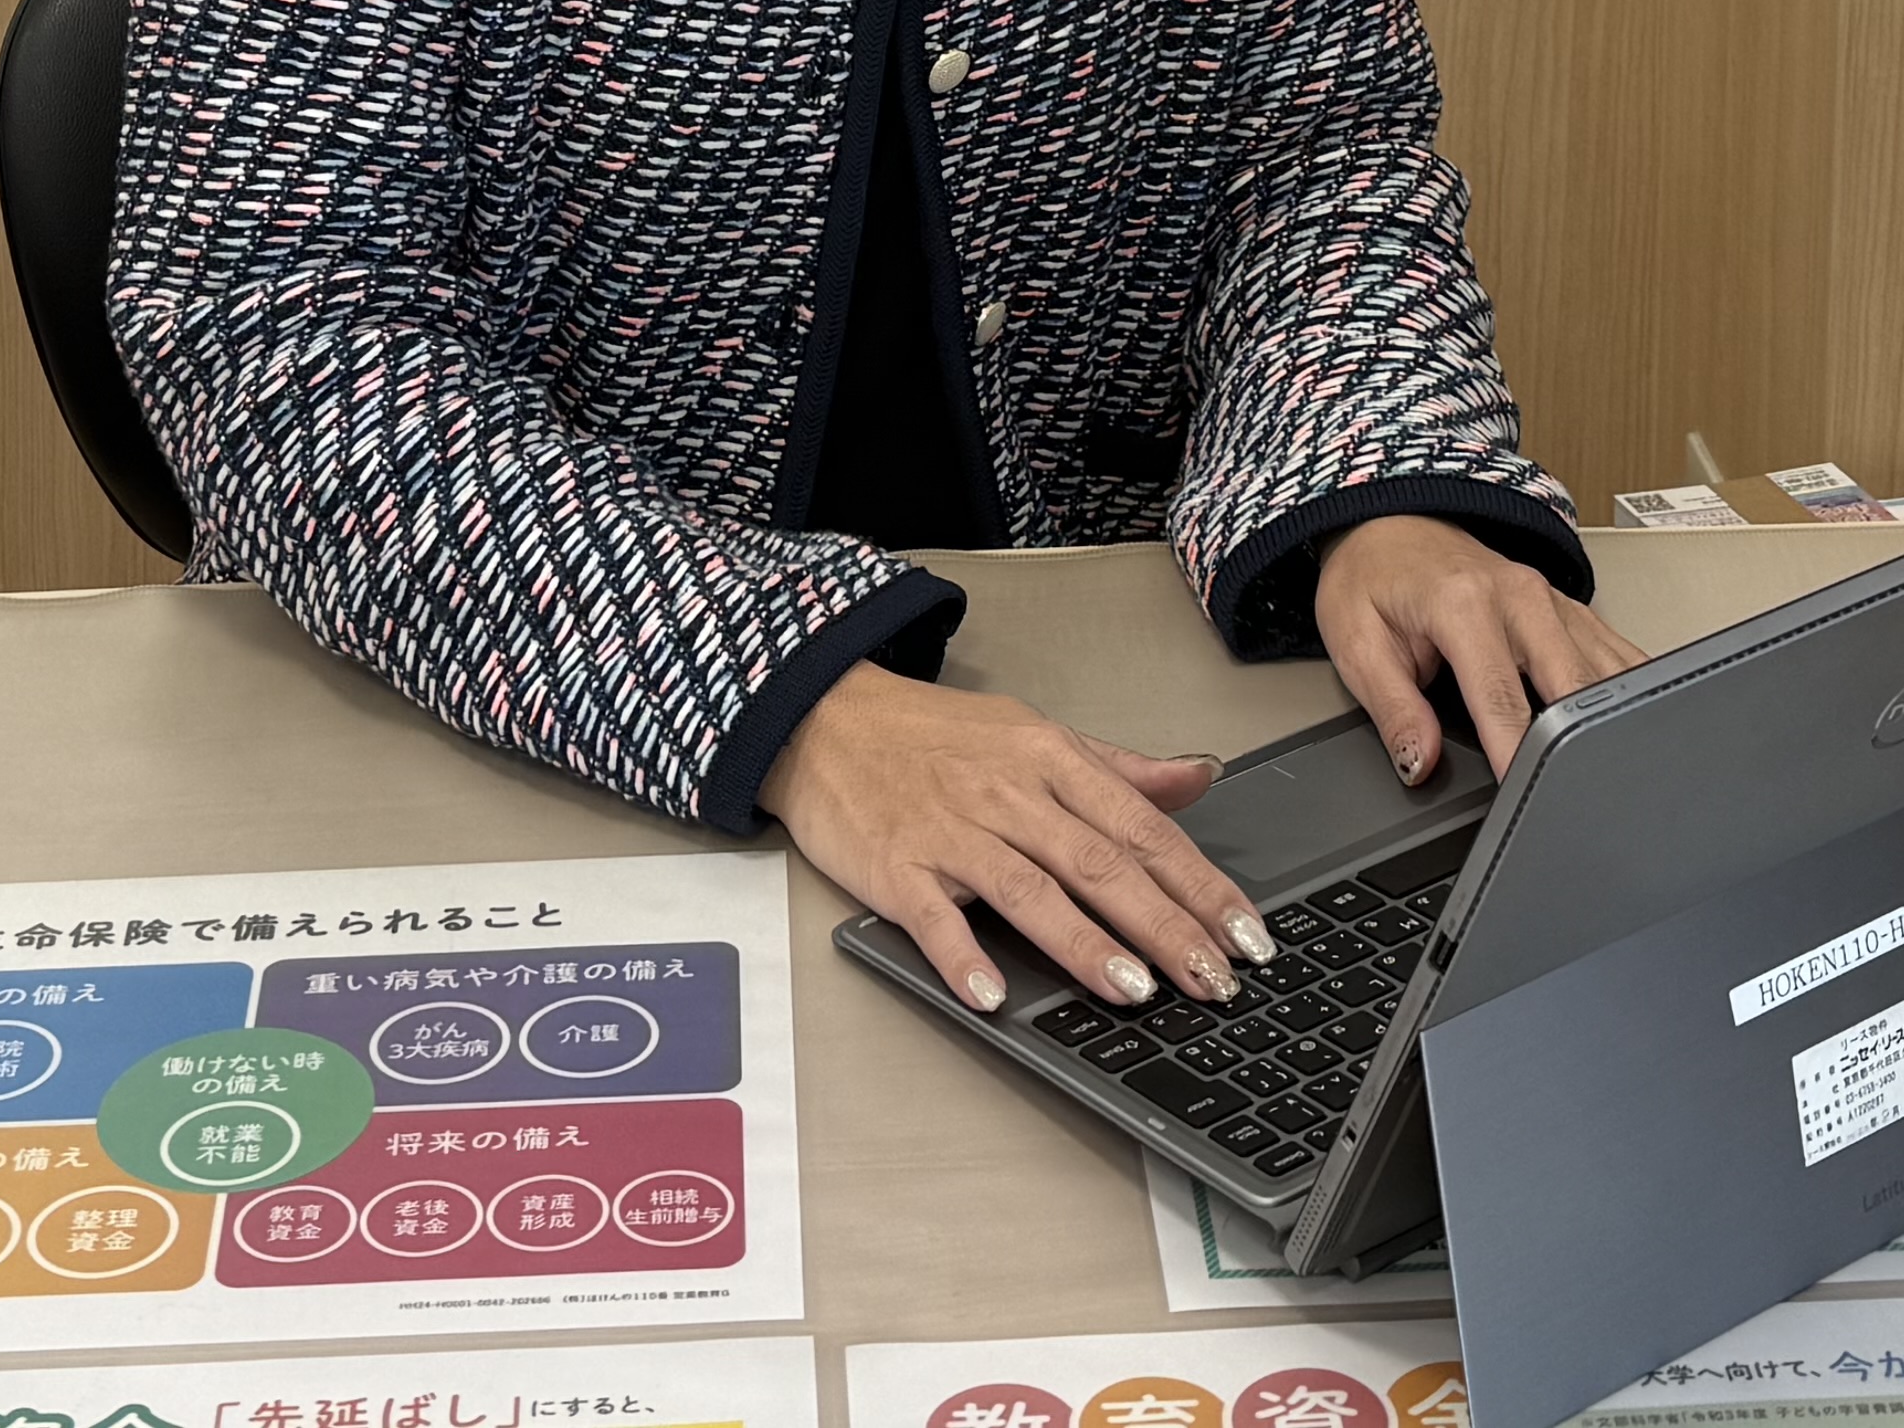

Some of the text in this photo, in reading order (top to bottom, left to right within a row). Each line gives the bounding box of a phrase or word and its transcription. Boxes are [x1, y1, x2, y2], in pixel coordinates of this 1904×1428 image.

[303, 957, 696, 997] 重い病気や介護の備え
[413, 1022, 468, 1040] がん
[559, 1022, 620, 1044] 介護
[387, 1038, 490, 1060] 3大疾病
[160, 1052, 327, 1079] 働けない時
[192, 1073, 289, 1095] の備え
[199, 1123, 264, 1144] 就業
[384, 1126, 591, 1158] 将来の備え
[195, 1144, 261, 1165] 不能
[520, 1194, 576, 1212] 資産
[649, 1187, 701, 1207] 相続
[70, 1208, 140, 1229] 整理
[268, 1203, 325, 1222] 教育
[394, 1198, 450, 1218] 老後
[625, 1206, 724, 1227] 生前贈与
[265, 1222, 323, 1241] 資金
[391, 1216, 449, 1238] 資金
[518, 1211, 576, 1231] 形成
[64, 1230, 137, 1252] 資金
